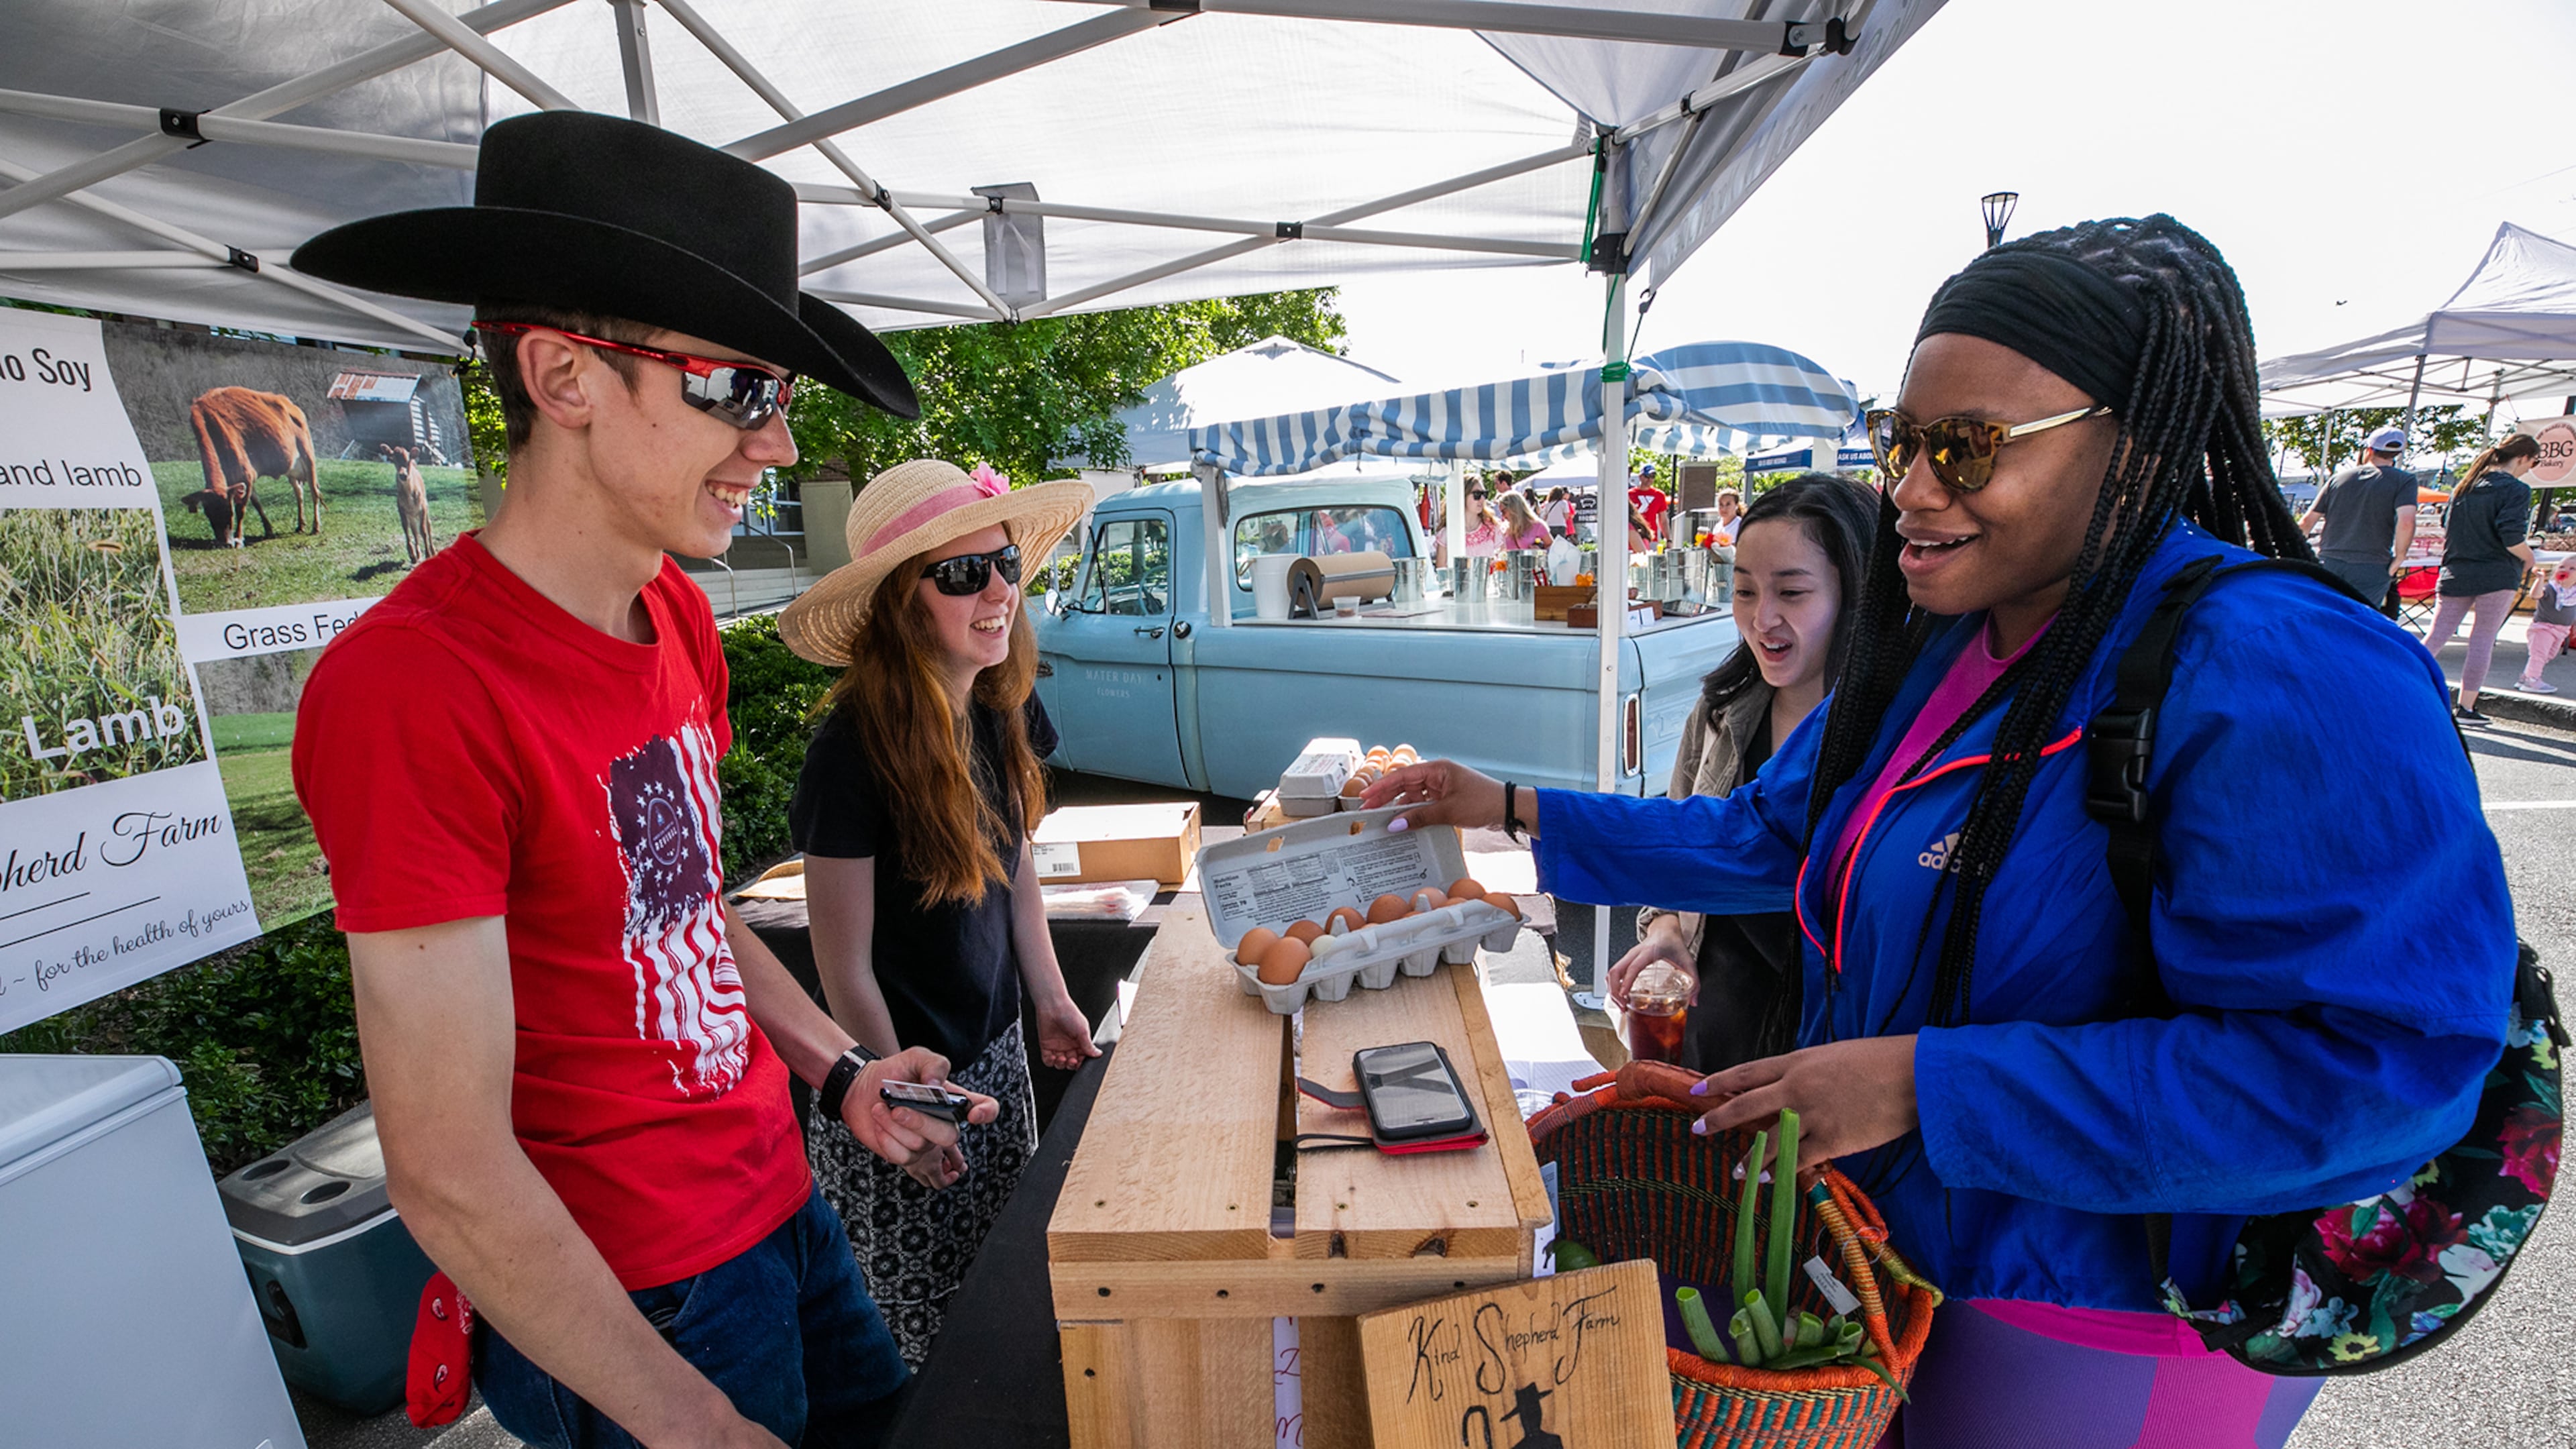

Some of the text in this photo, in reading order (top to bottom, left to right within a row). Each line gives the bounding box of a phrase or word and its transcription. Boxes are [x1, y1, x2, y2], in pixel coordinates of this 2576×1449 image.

[32, 347, 91, 392] Soy
[1838, 453, 1849, 461] ASK
[1858, 451, 1874, 460] ABOU
[2534, 440, 2573, 459] BBG
[61, 460, 142, 487] lamb
[223, 622, 307, 650] Grass
[21, 695, 186, 761] Lamb
[0, 812, 222, 892] herd Farm
[35, 959, 70, 992] for
[71, 946, 109, 968] the
[113, 920, 174, 955] health
[178, 909, 199, 938] of
[201, 900, 250, 933] yours
[1407, 1285, 1620, 1405] Kind Shepherd Farm
